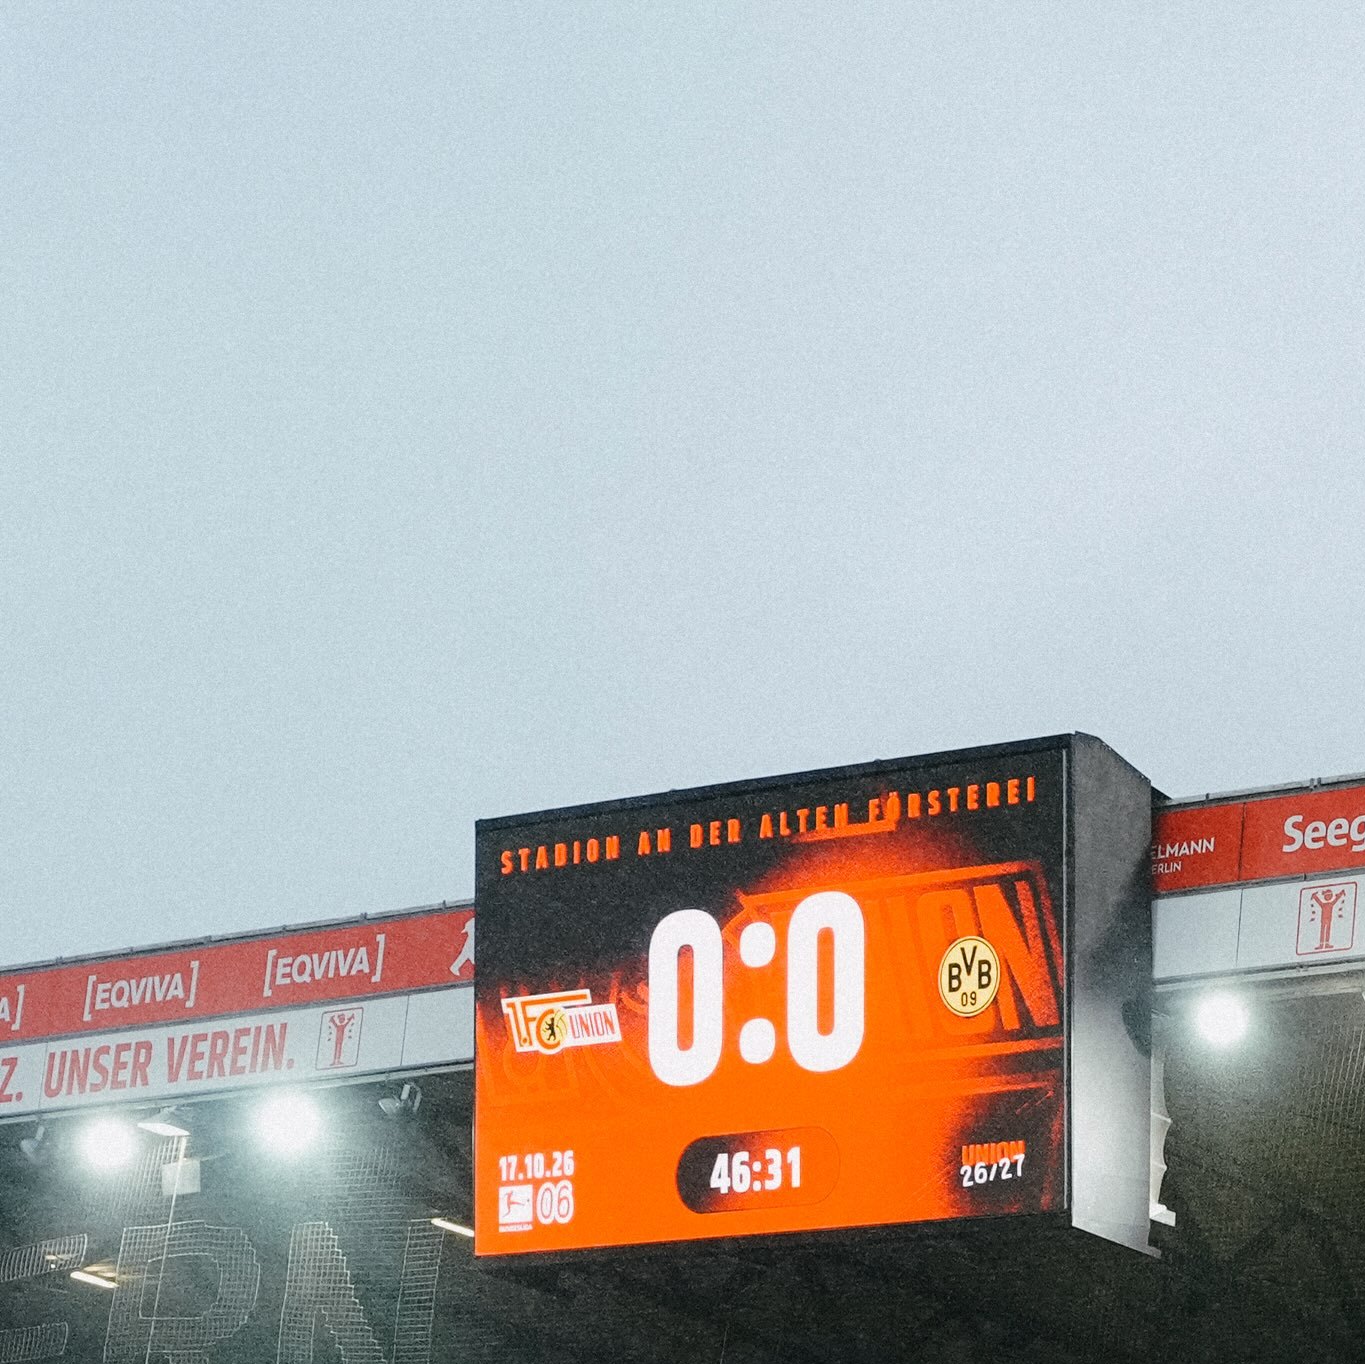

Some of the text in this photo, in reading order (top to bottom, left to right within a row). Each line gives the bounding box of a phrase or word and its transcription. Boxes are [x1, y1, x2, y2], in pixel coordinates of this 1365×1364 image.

[501, 776, 1035, 874] STADION AN DER ALTEN FÖRSTEREI
[648, 891, 864, 1086] 0:0
[948, 945, 992, 993] BVB
[961, 990, 977, 1007] 09
[569, 1010, 616, 1040] UNION
[43, 1039, 153, 1098] UNSER
[167, 1021, 295, 1086] VEREIN.
[499, 1150, 574, 1182] 17.10.26
[709, 1146, 802, 1195] 46:31
[959, 1153, 1025, 1188] 26/27
[536, 1179, 574, 1225] 06
